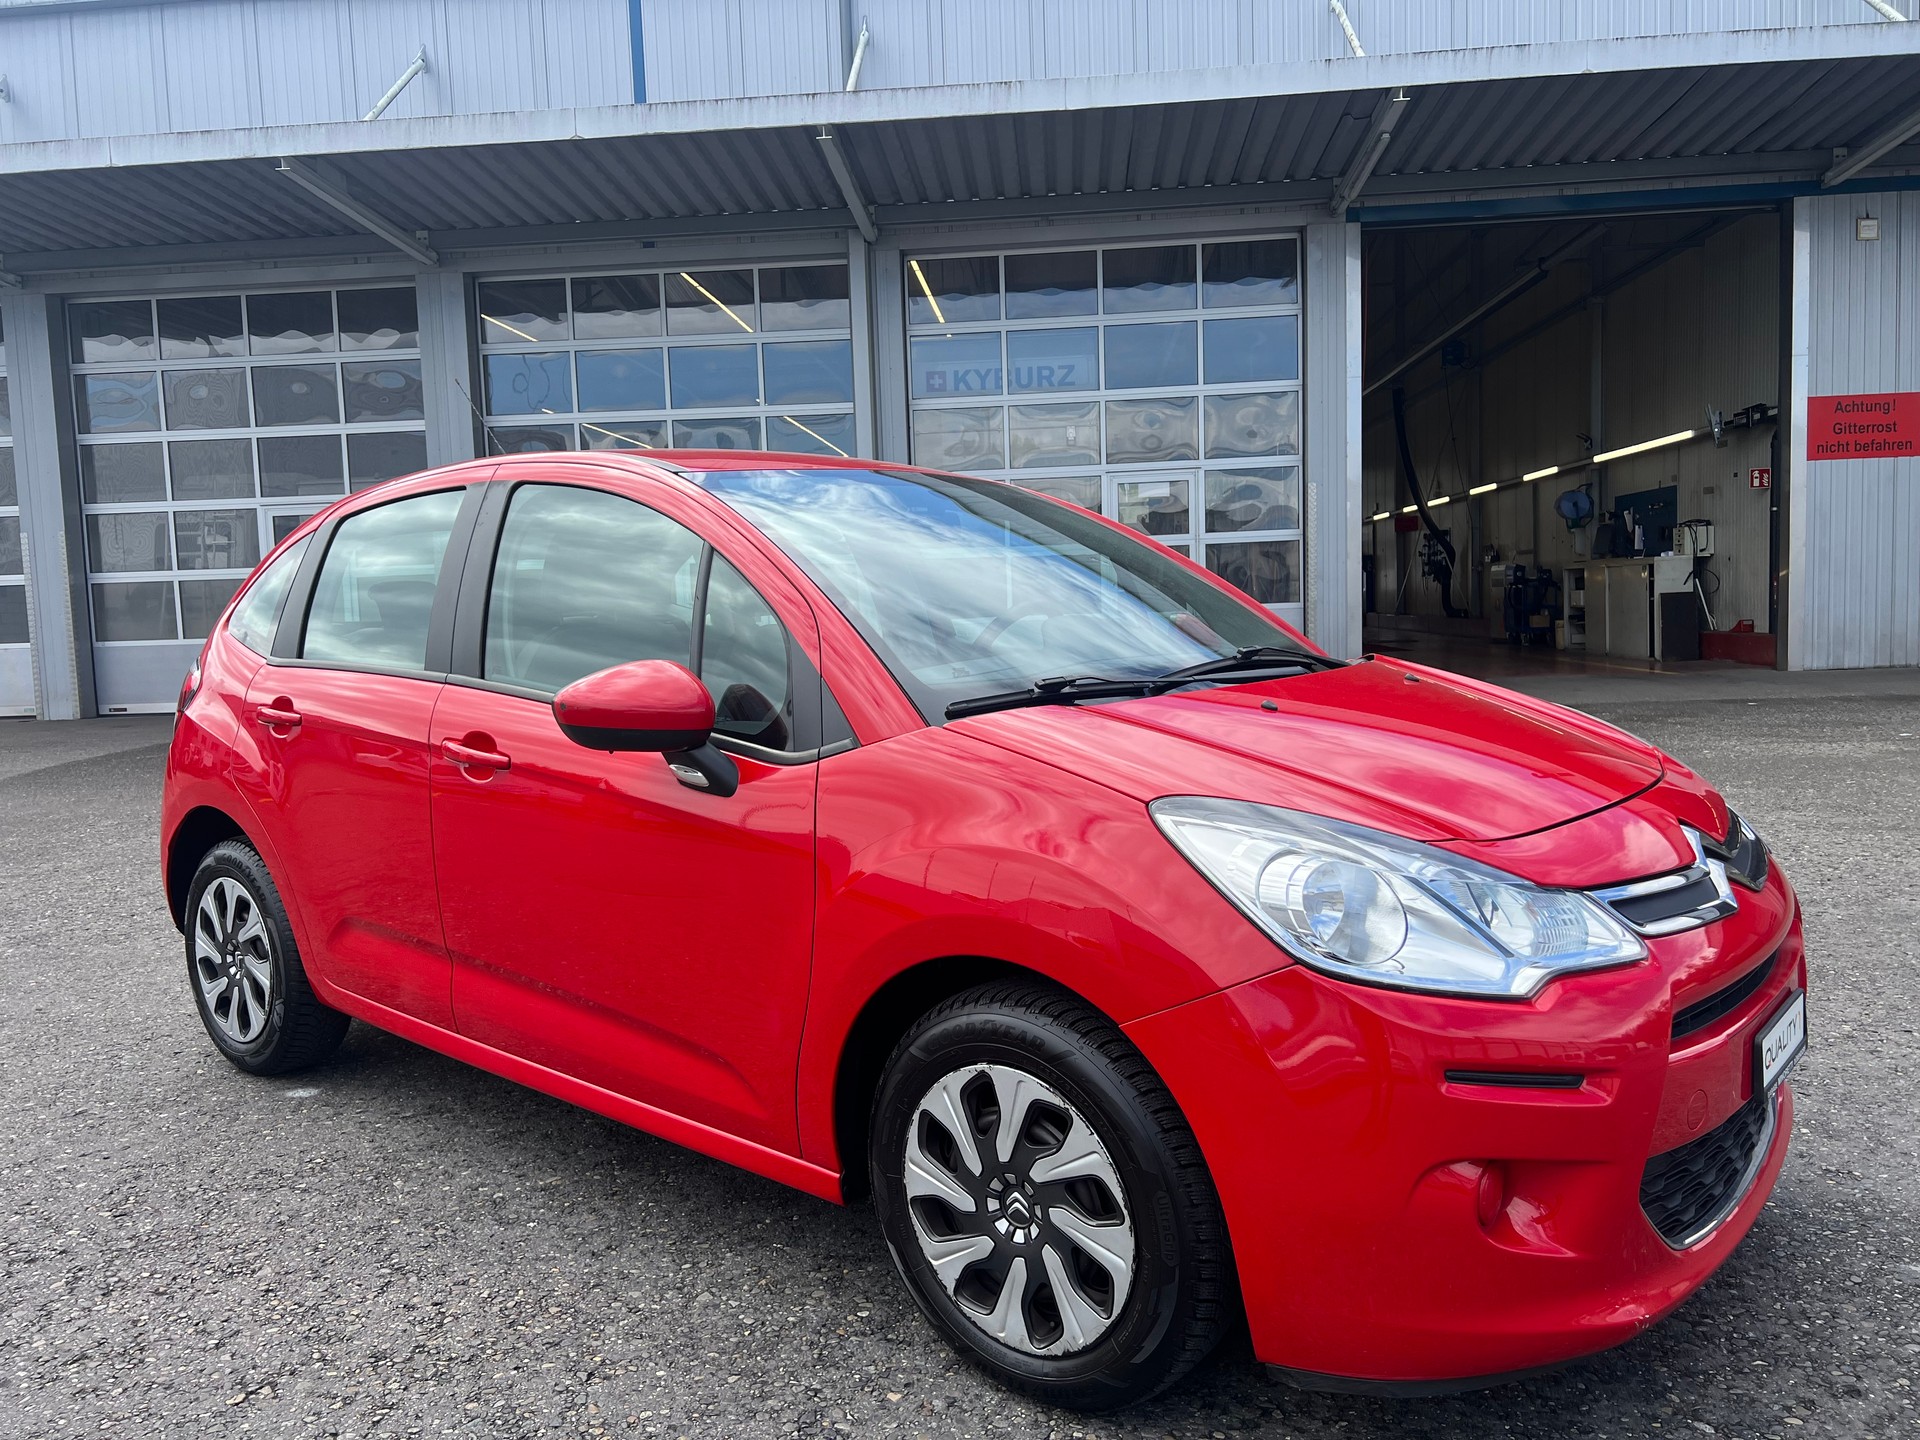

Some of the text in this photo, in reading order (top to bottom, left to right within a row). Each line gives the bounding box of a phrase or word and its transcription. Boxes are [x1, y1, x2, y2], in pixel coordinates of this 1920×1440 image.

[953, 364, 1076, 392] KYBURZ
[1834, 398, 1896, 415] Achtung!
[1832, 420, 1897, 435] Gitterrost
[1816, 438, 1913, 454] nicht befahren
